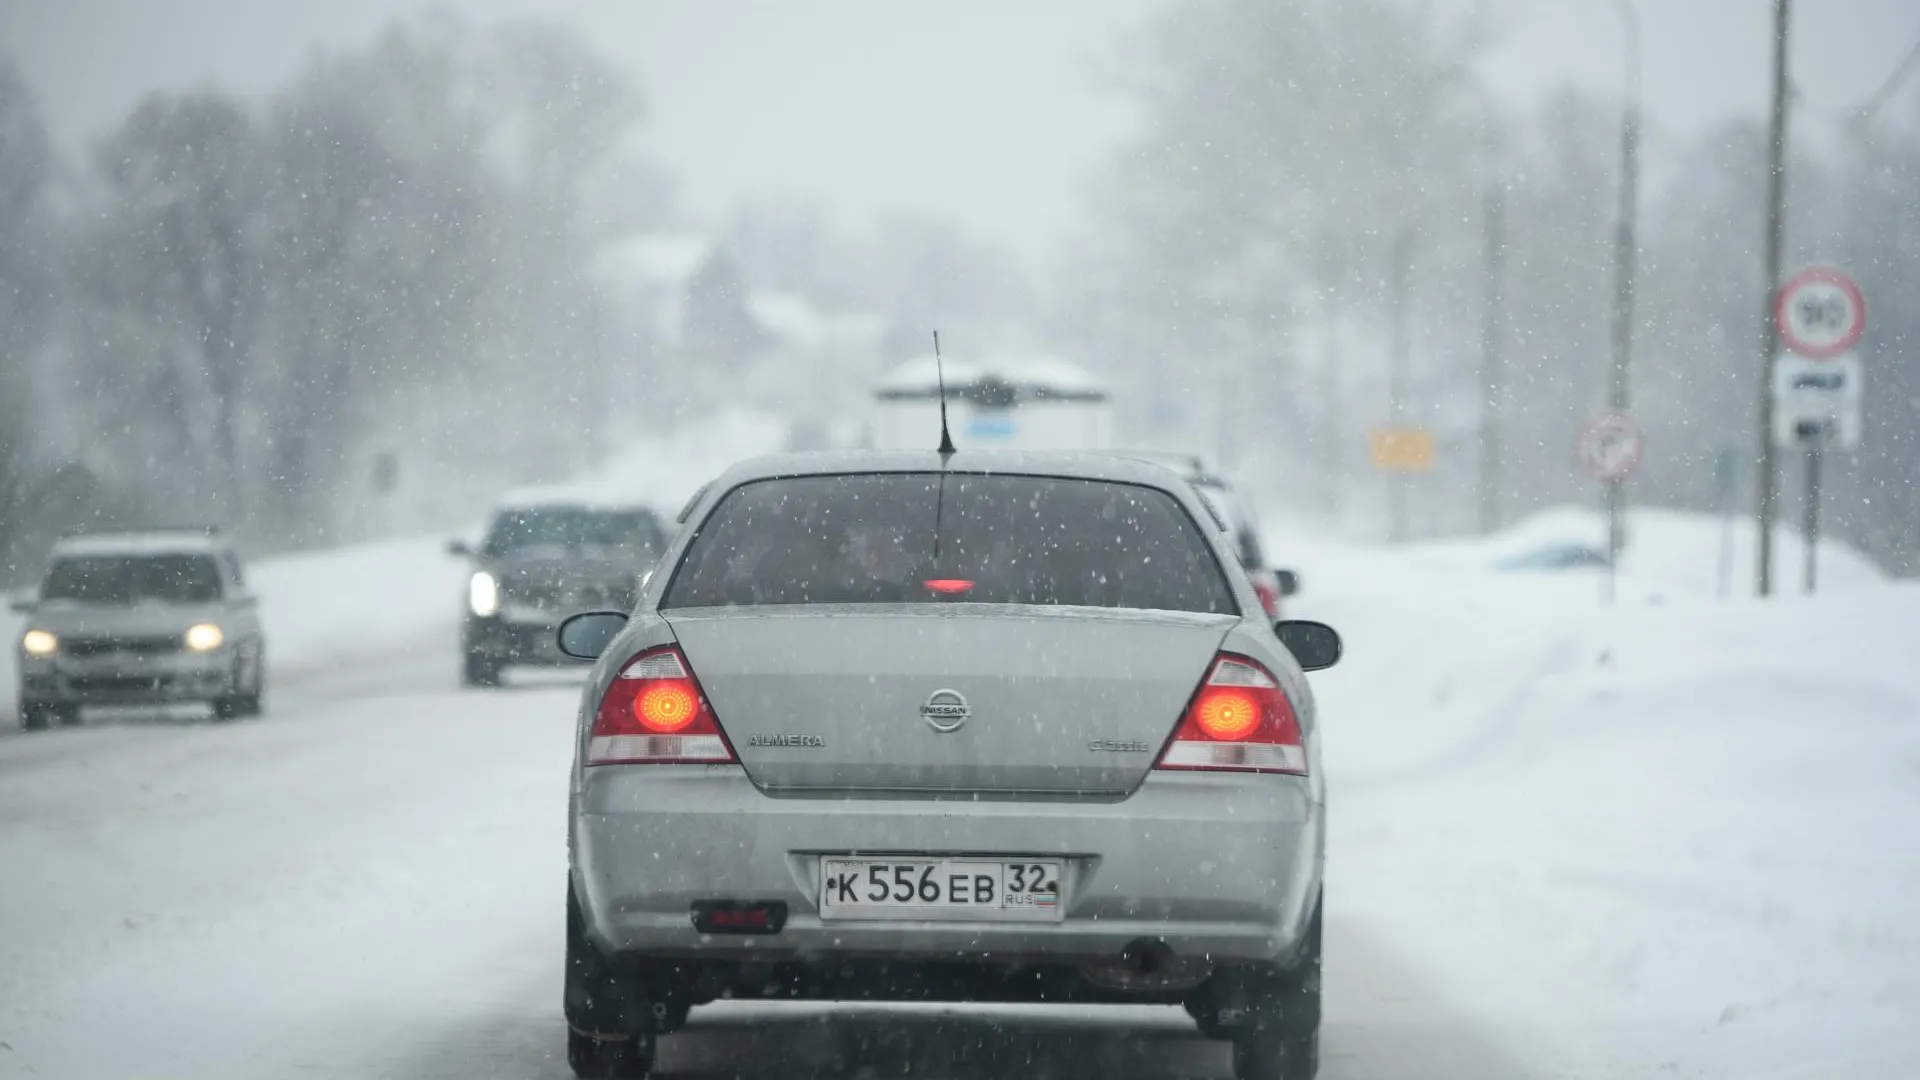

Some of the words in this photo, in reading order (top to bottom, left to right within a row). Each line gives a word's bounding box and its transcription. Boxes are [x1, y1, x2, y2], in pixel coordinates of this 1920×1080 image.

[748, 734, 824, 747] ALMERA
[1008, 864, 1045, 893] 32
[1005, 893, 1034, 905] RUS
